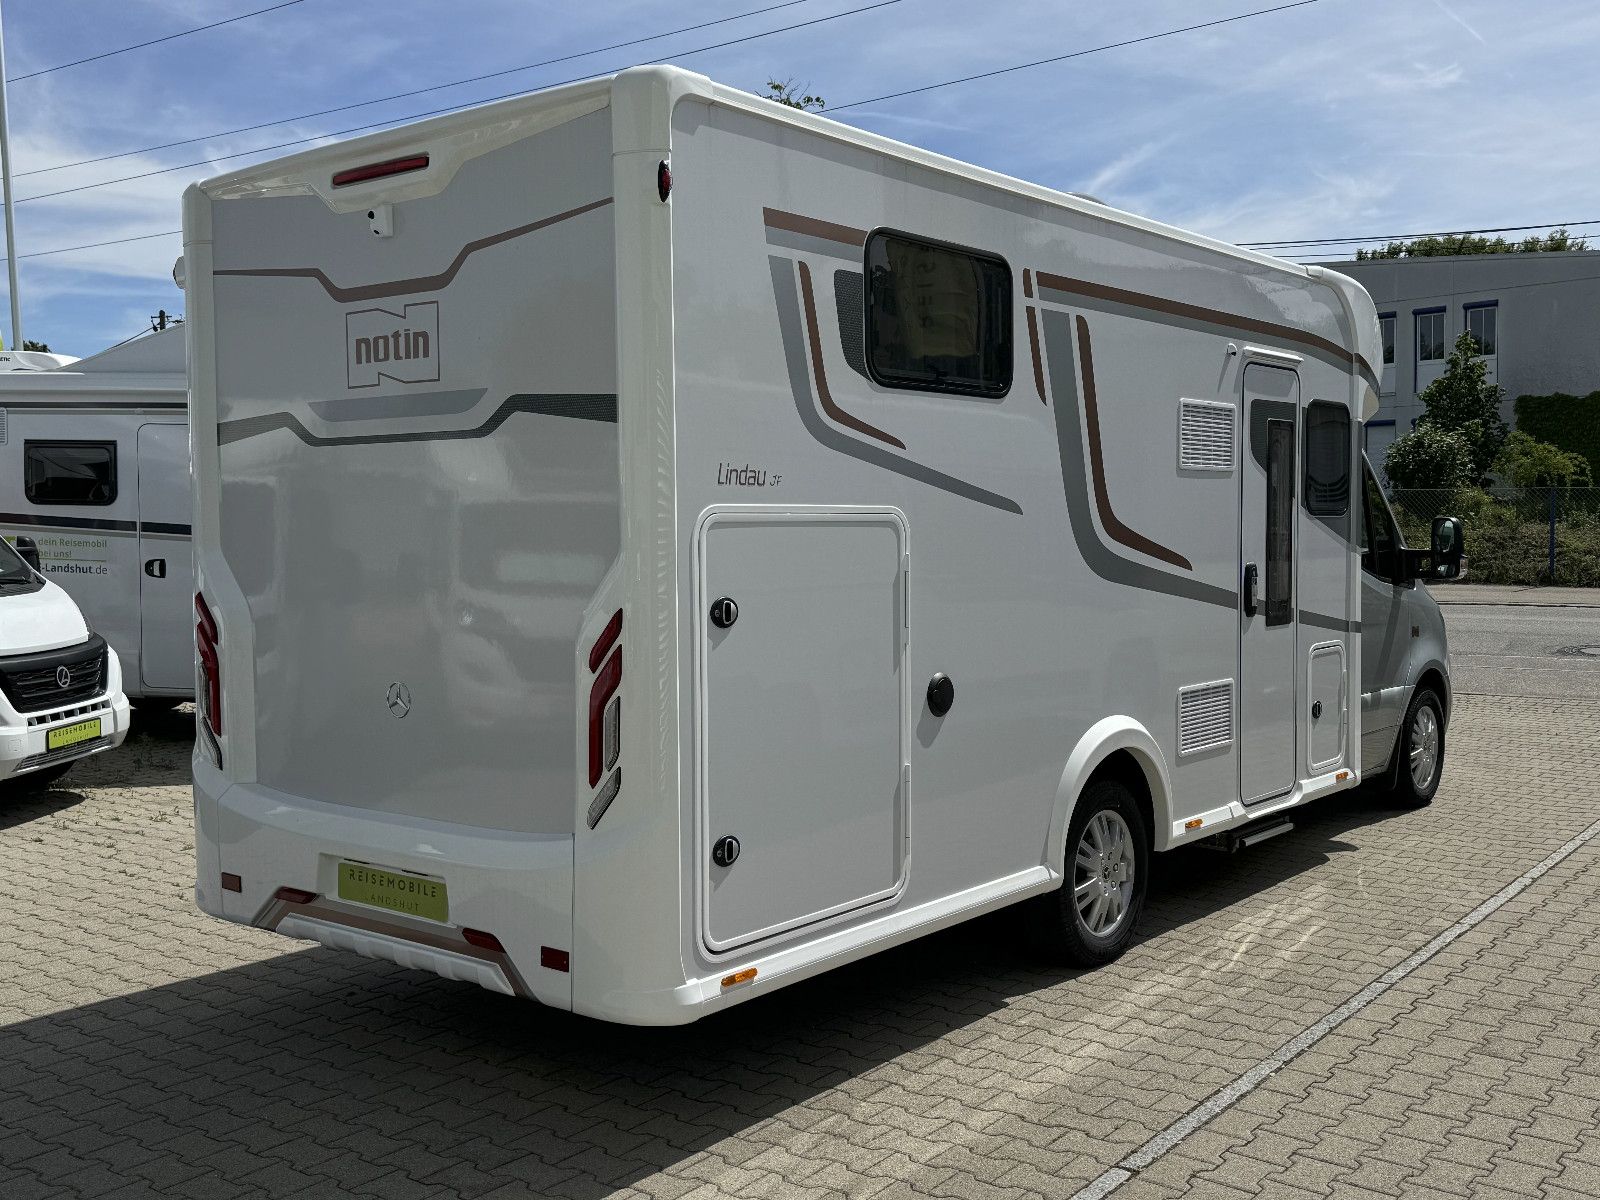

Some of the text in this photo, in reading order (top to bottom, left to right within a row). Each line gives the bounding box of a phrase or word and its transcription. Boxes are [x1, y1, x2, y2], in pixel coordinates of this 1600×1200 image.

[355, 328, 430, 365] notin
[717, 462, 767, 487] Lindau
[38, 537, 107, 548] dein Reisemobil
[53, 550, 72, 558] uns!
[348, 868, 437, 898] REISEMOBILE
